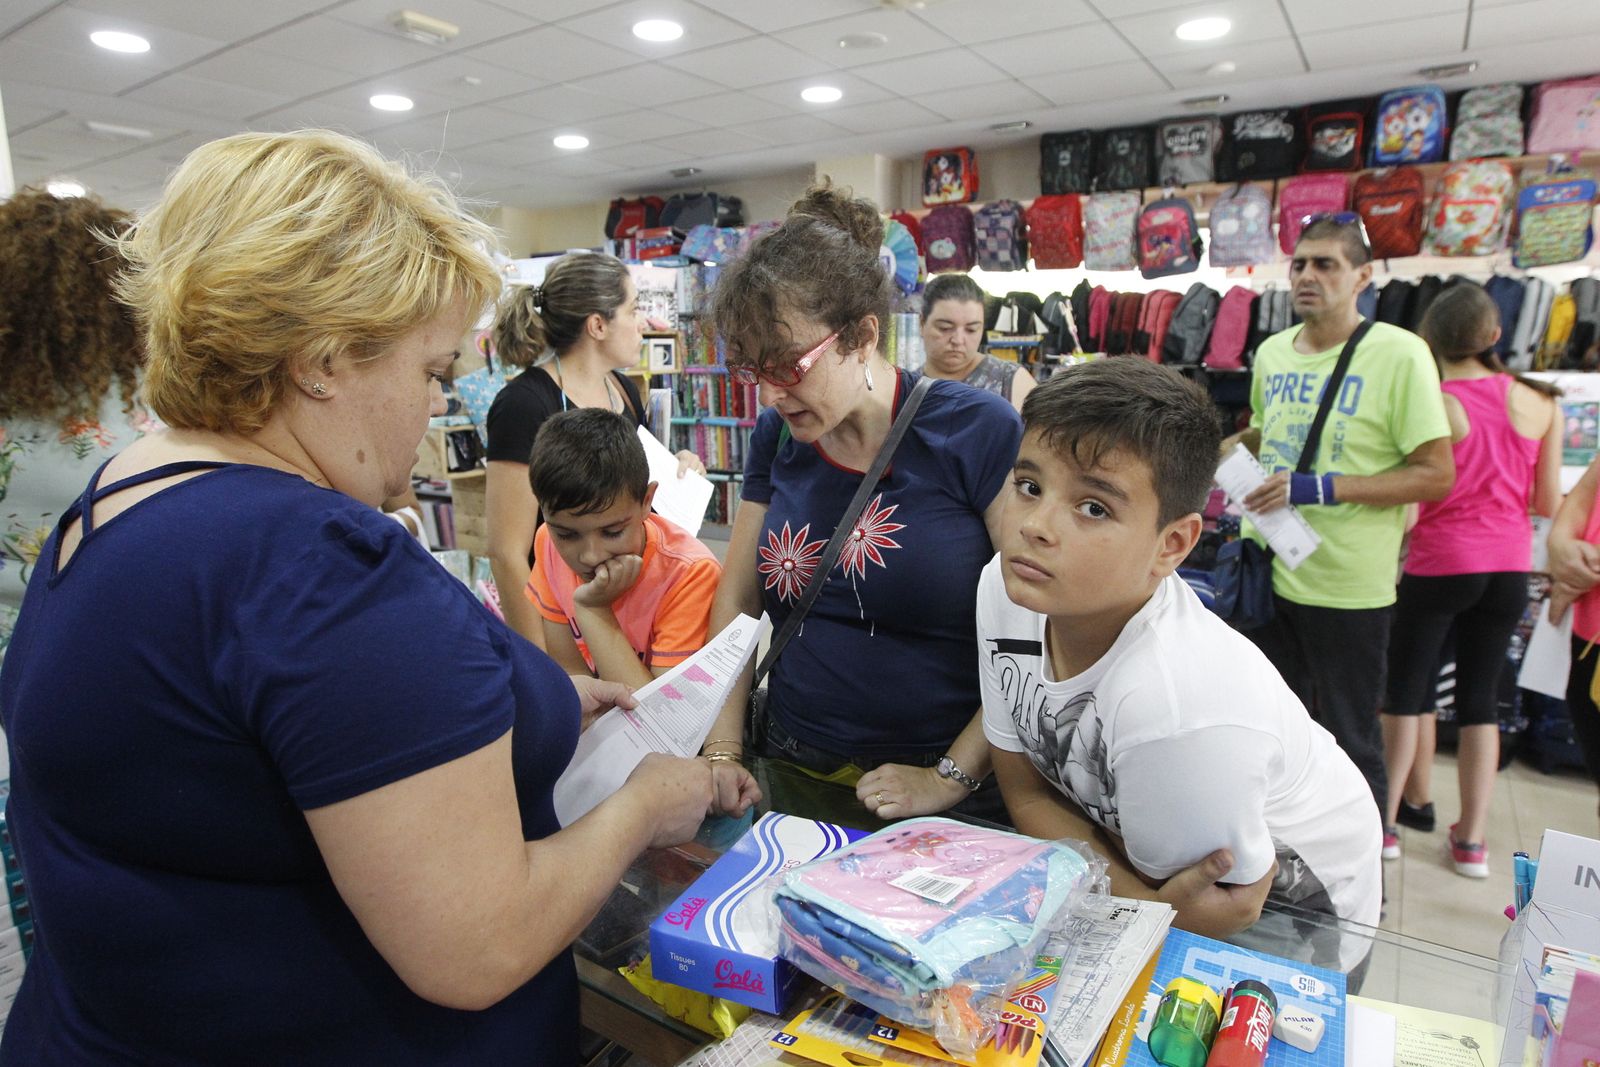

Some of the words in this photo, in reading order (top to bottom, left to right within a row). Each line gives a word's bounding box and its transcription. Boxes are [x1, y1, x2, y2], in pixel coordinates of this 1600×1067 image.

[664, 897, 707, 931] Oplà
[669, 951, 696, 966] Tissues
[678, 962, 689, 972] 80
[713, 960, 766, 995] Oplà
[777, 1033, 794, 1045] 12
[876, 1025, 894, 1039] 12
